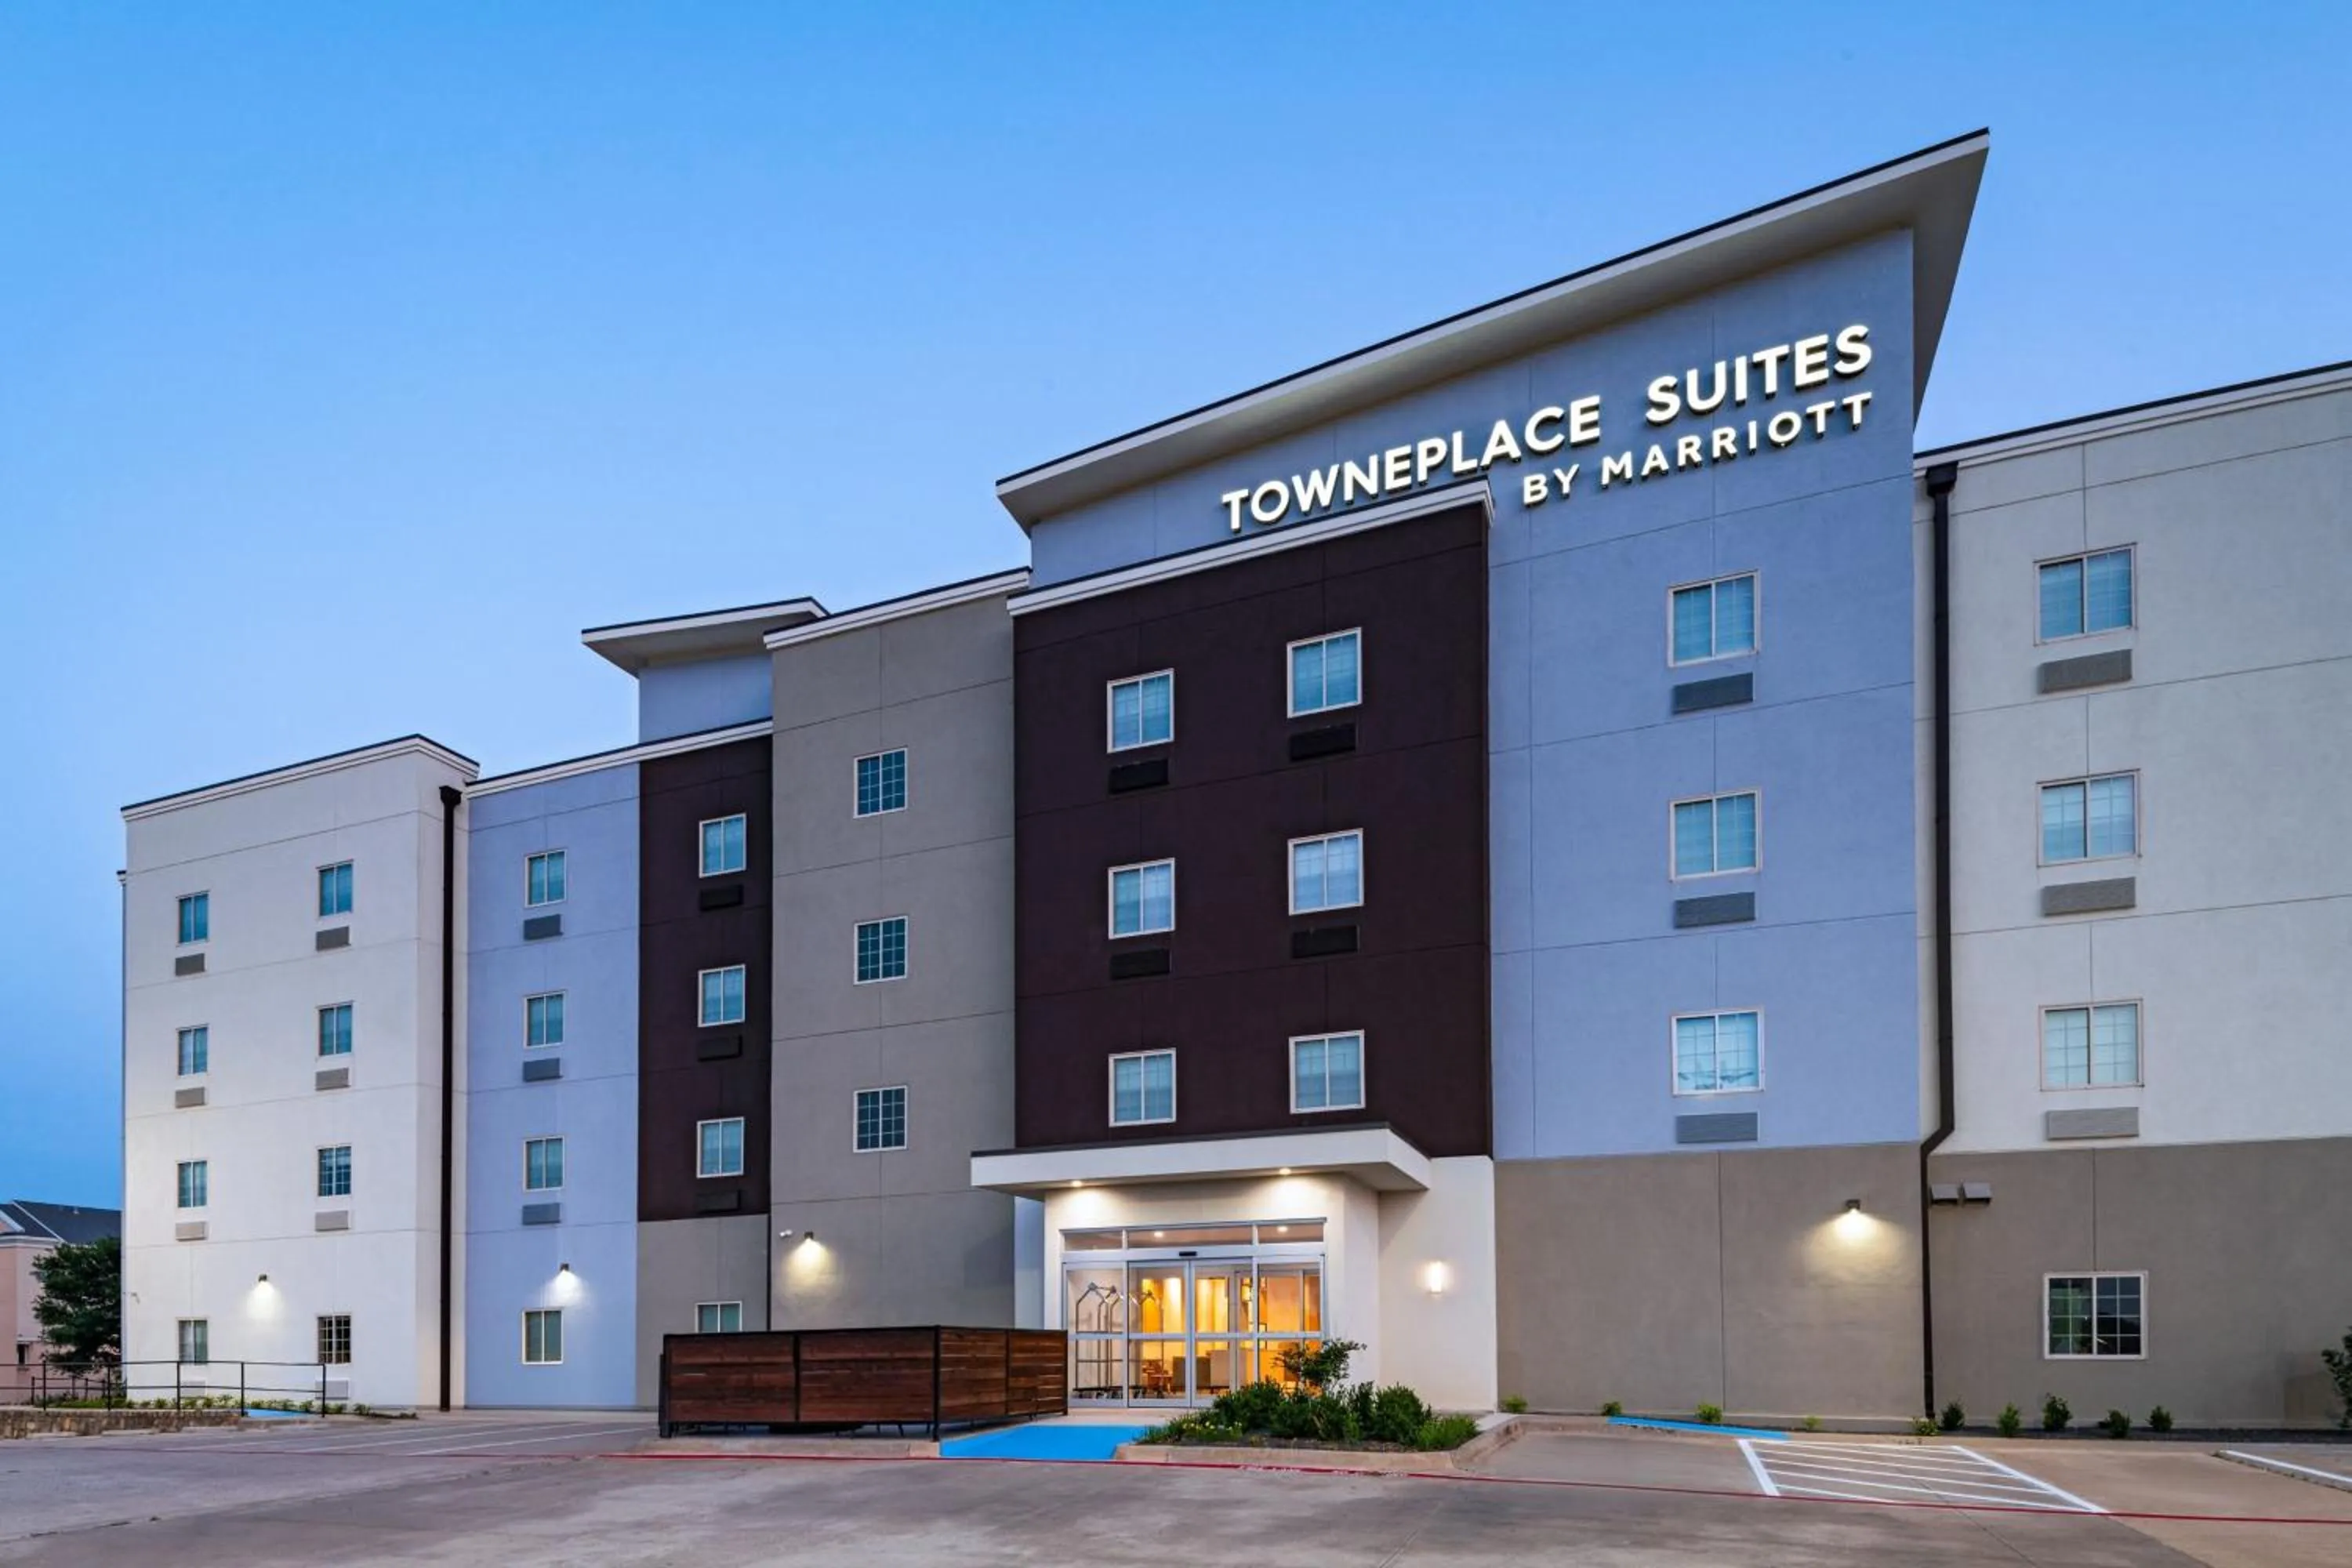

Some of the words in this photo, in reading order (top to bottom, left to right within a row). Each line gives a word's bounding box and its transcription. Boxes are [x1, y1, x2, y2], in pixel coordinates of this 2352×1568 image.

[1221, 395, 1602, 531] TOWNEPLACE
[1645, 325, 1872, 423] SUITES
[1522, 464, 1579, 505] BY
[1600, 391, 1872, 486] MARRIOTT
